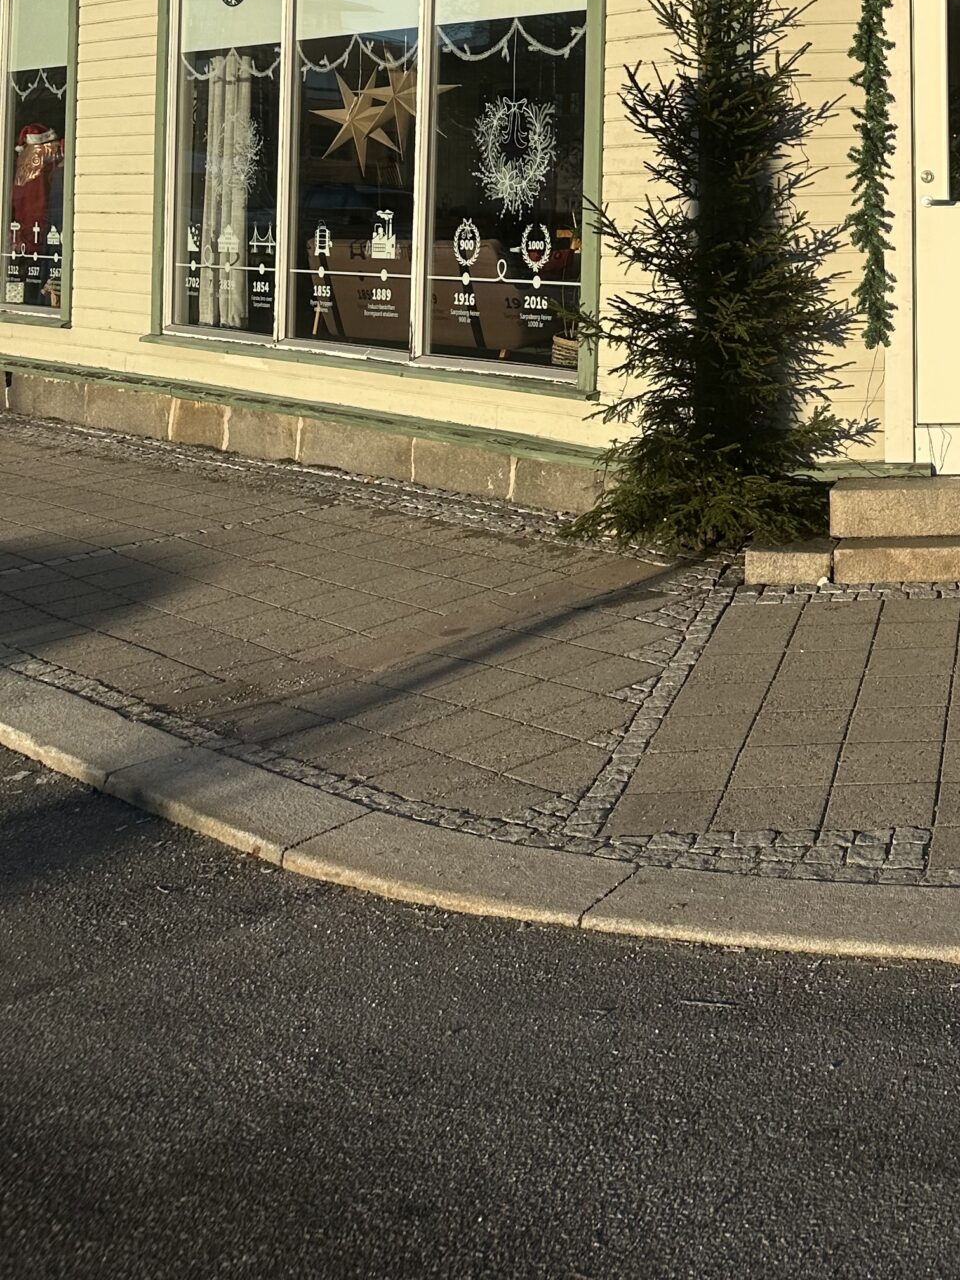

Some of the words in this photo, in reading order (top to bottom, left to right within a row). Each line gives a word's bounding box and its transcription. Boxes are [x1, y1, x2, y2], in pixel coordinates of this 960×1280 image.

[460, 240, 474, 250] 900
[528, 240, 544, 250] 1000
[8, 265, 19, 275] 1312
[28, 266, 40, 275] 1537
[185, 277, 199, 288] 1702
[253, 281, 269, 292] 1854
[314, 285, 331, 297] 1855
[372, 288, 392, 300] 1889
[454, 293, 475, 306] 1916
[524, 296, 548, 309] 2016
